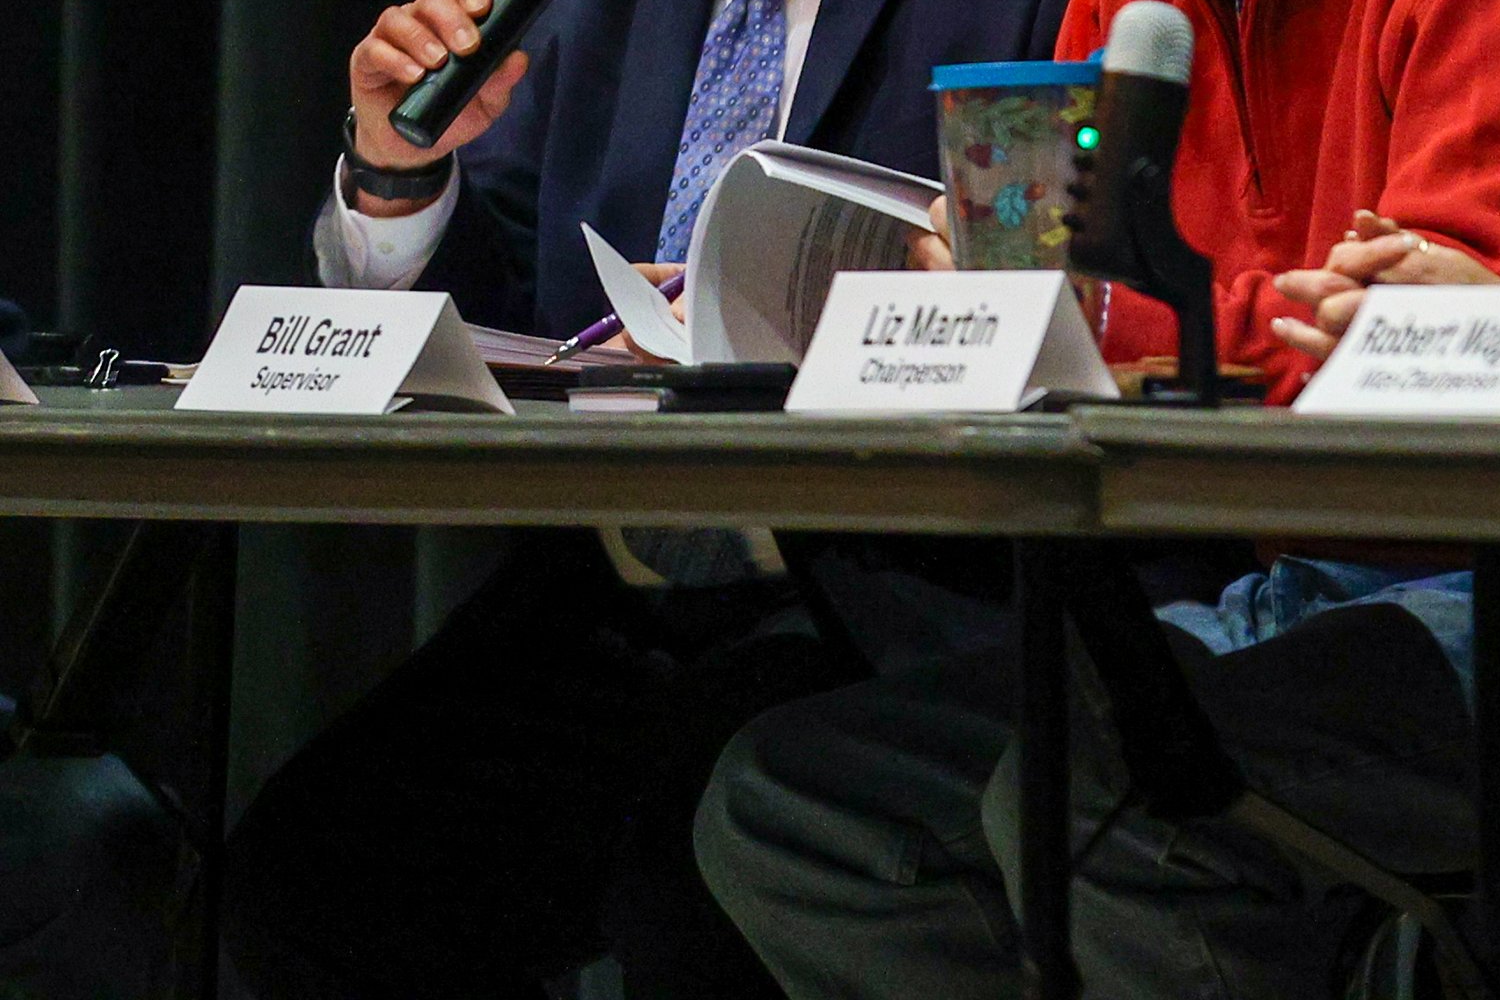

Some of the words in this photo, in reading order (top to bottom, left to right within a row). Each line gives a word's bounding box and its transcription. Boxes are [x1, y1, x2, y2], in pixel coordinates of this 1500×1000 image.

[256, 315, 310, 355] Bill
[304, 318, 382, 358] Grant
[862, 302, 905, 346] Liz
[904, 302, 999, 347] Martin
[1360, 313, 1460, 356] Robert
[250, 365, 340, 396] Supervisor
[859, 357, 967, 391] Chairperson
